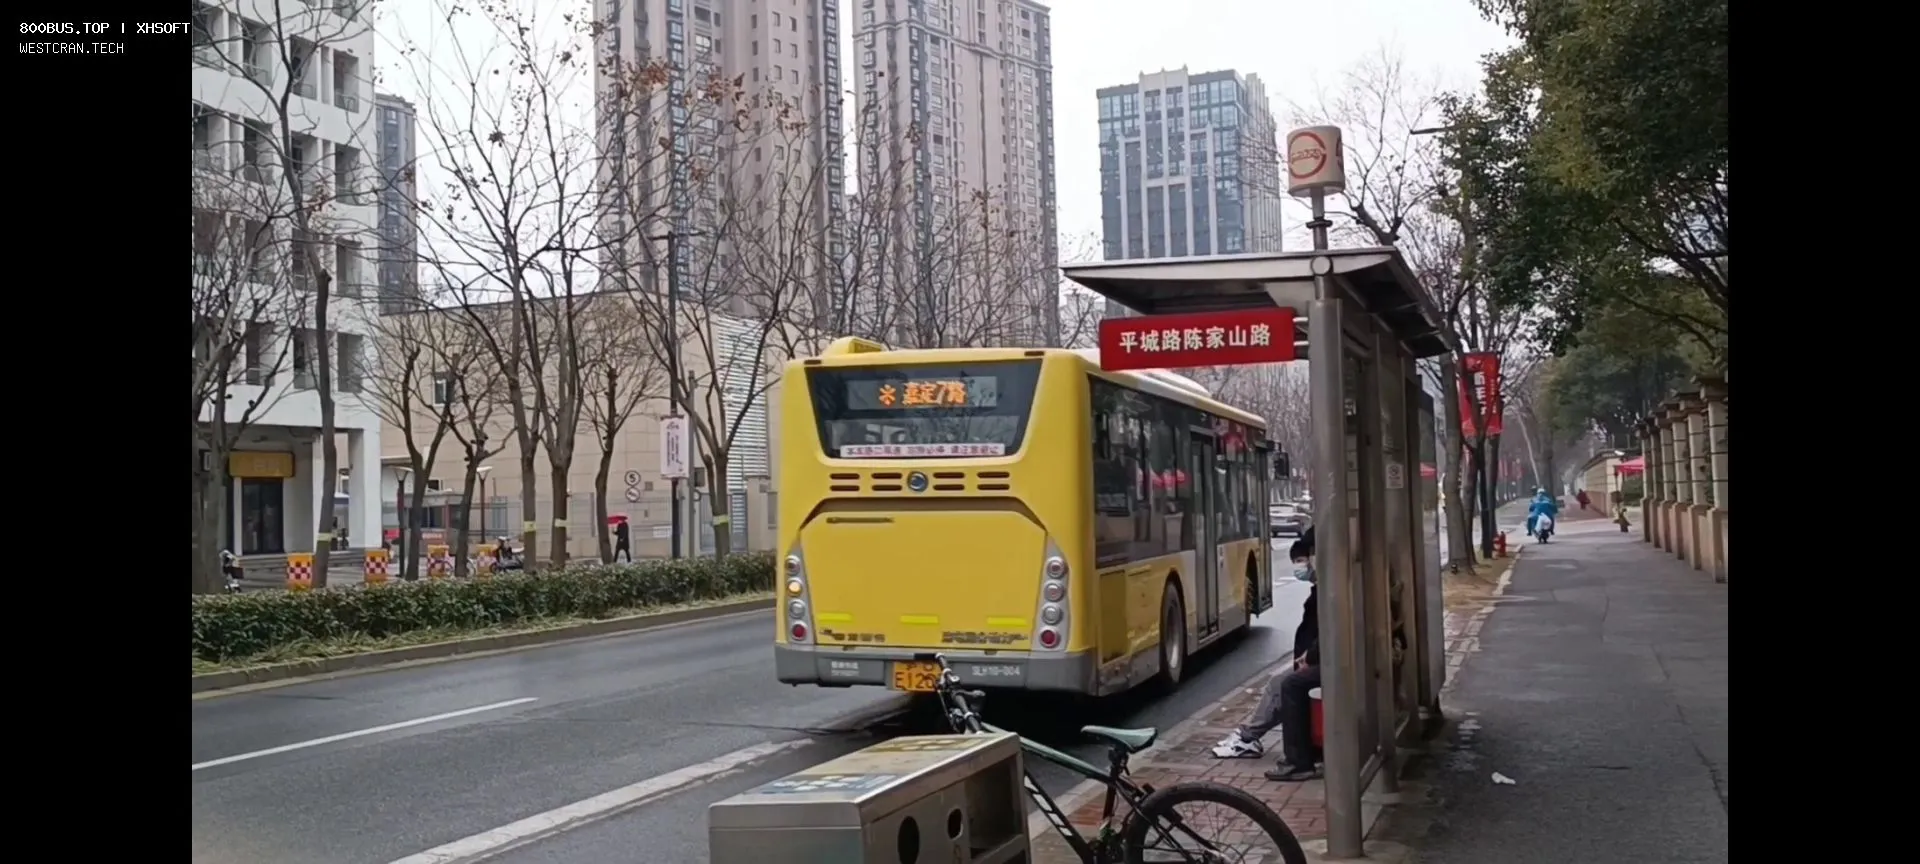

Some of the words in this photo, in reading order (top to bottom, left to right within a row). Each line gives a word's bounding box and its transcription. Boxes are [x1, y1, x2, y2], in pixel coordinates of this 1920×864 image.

[1119, 323, 1271, 353] 平城路陈家山路
